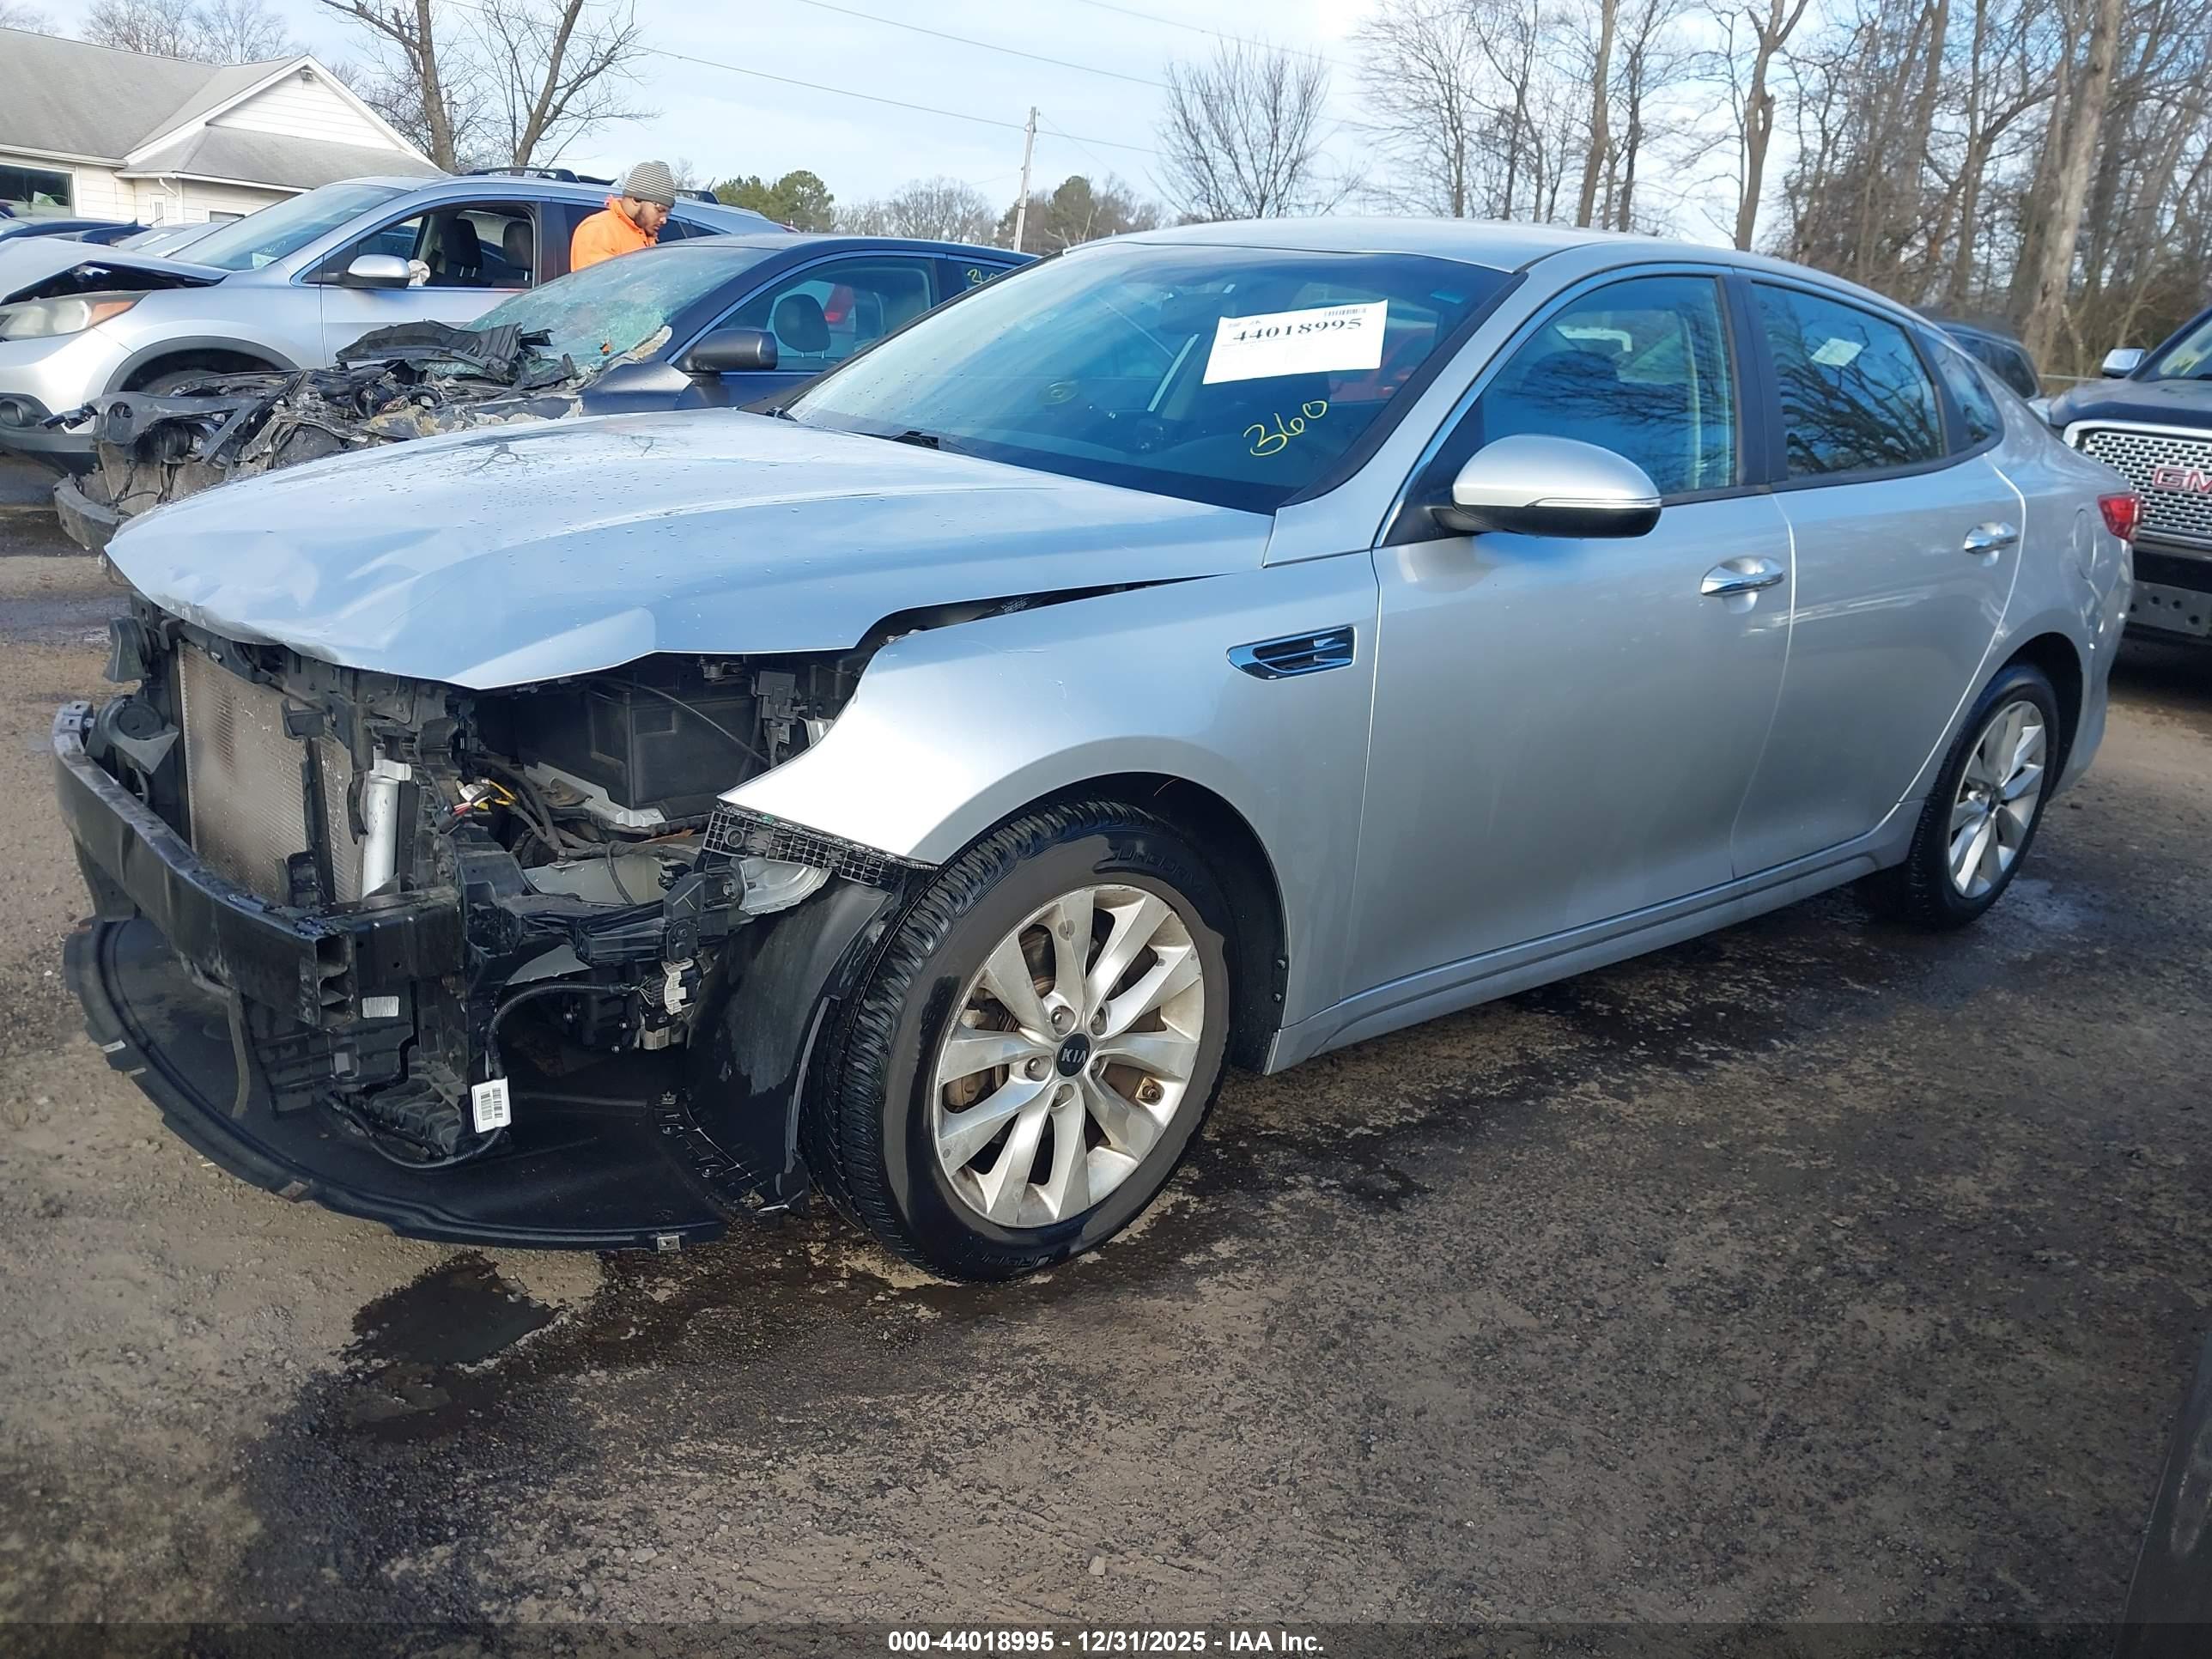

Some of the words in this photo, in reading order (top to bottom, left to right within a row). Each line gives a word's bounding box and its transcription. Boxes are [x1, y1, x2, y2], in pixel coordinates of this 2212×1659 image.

[1233, 317, 1364, 343] 44018995
[1243, 399, 1328, 456] 360
[1061, 1048, 1087, 1063] KIA
